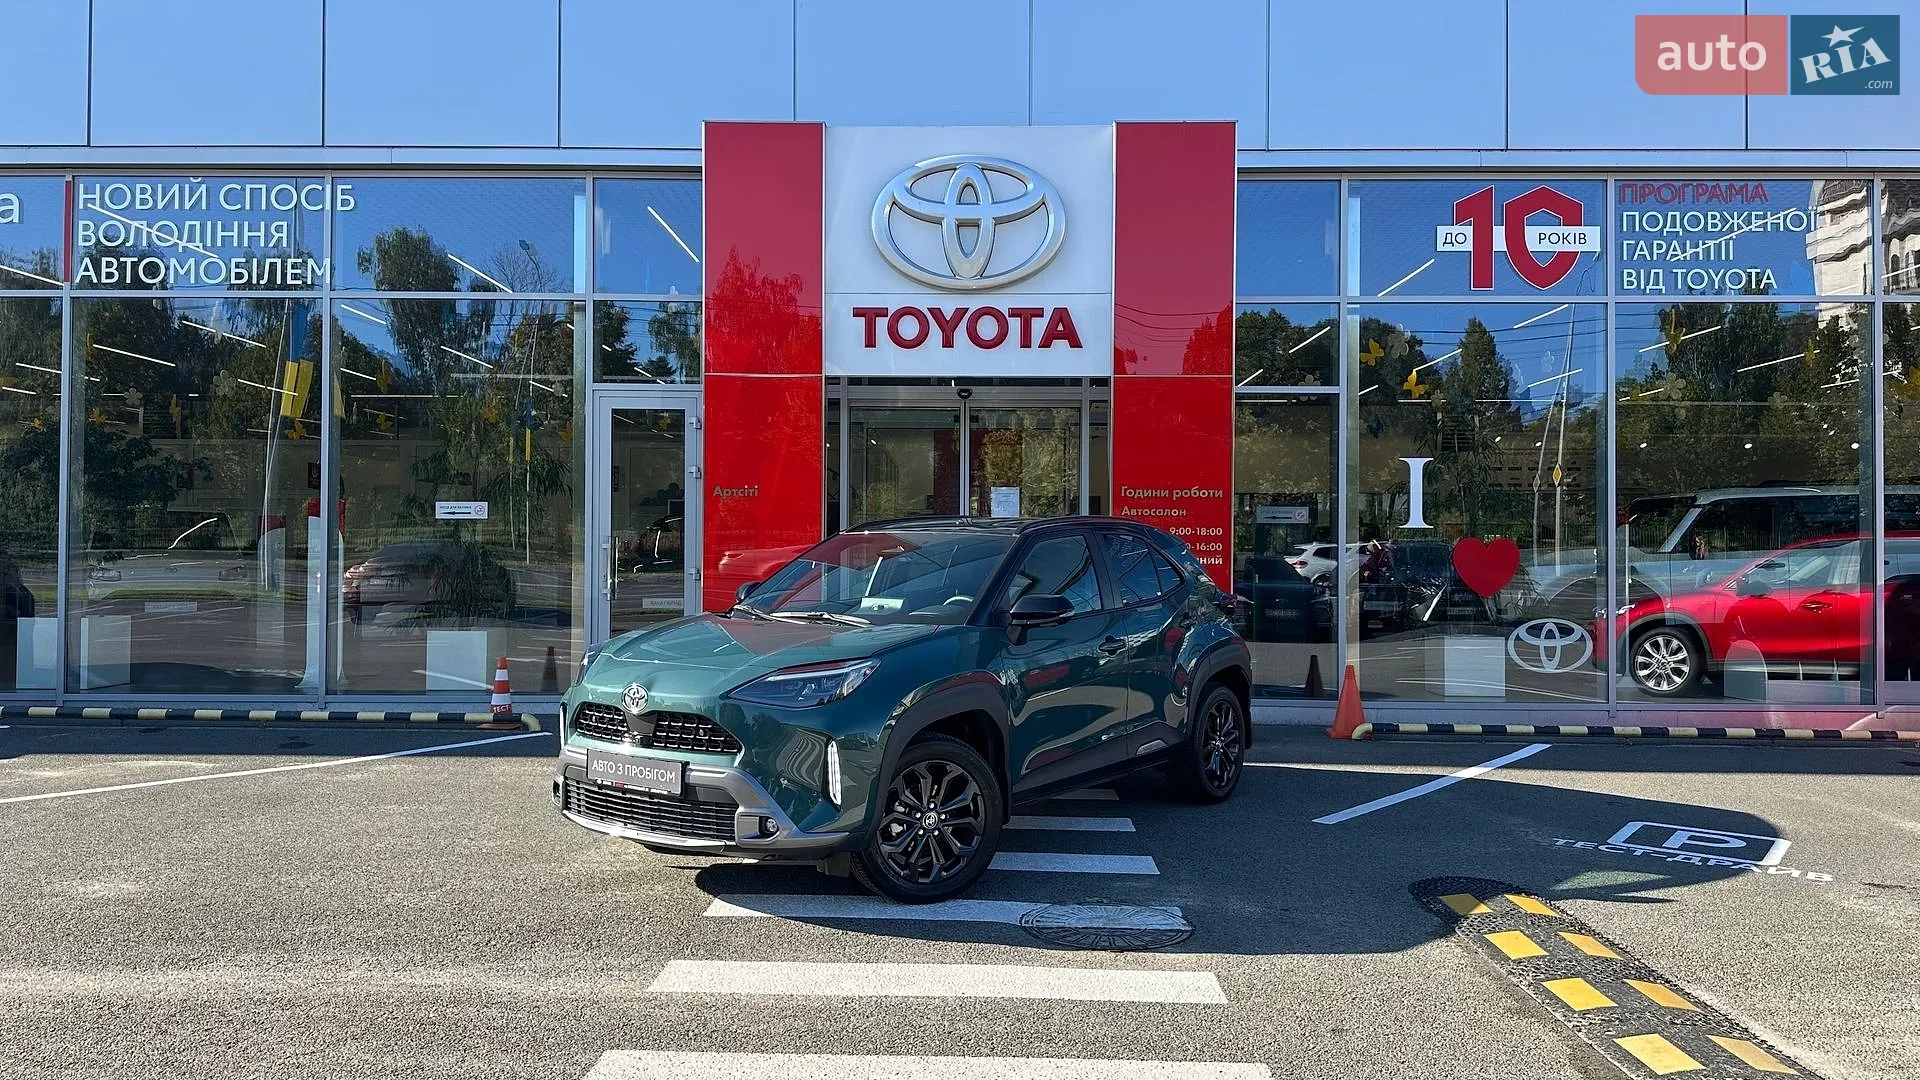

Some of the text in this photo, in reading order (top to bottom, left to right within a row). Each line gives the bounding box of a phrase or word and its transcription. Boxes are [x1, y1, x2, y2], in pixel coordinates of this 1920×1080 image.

[79, 177, 356, 211] НОВИЙ СПОСІБ
[1619, 182, 1769, 204] ПРОГРАМА
[1622, 206, 1818, 236] ПОДОВЖЕНОЇ
[78, 220, 288, 253] ВОЛОДІННЯ
[1442, 185, 1588, 290] ДО 10 РОКІВ
[1622, 236, 1736, 261] ГАРАНТІЇ
[75, 257, 331, 285] АВТОМОБІЛЕМ
[1623, 268, 1778, 294] ВІД TOYOTA
[852, 305, 1084, 350] TOYOTA
[713, 485, 758, 501] Артсіті
[1121, 486, 1223, 500] Години роботи
[1121, 506, 1187, 517] Автосалон
[592, 760, 676, 783] АВТО З ПРОБІГОМ
[1553, 838, 1833, 882] ТЕСТ-ДРАЙВ
